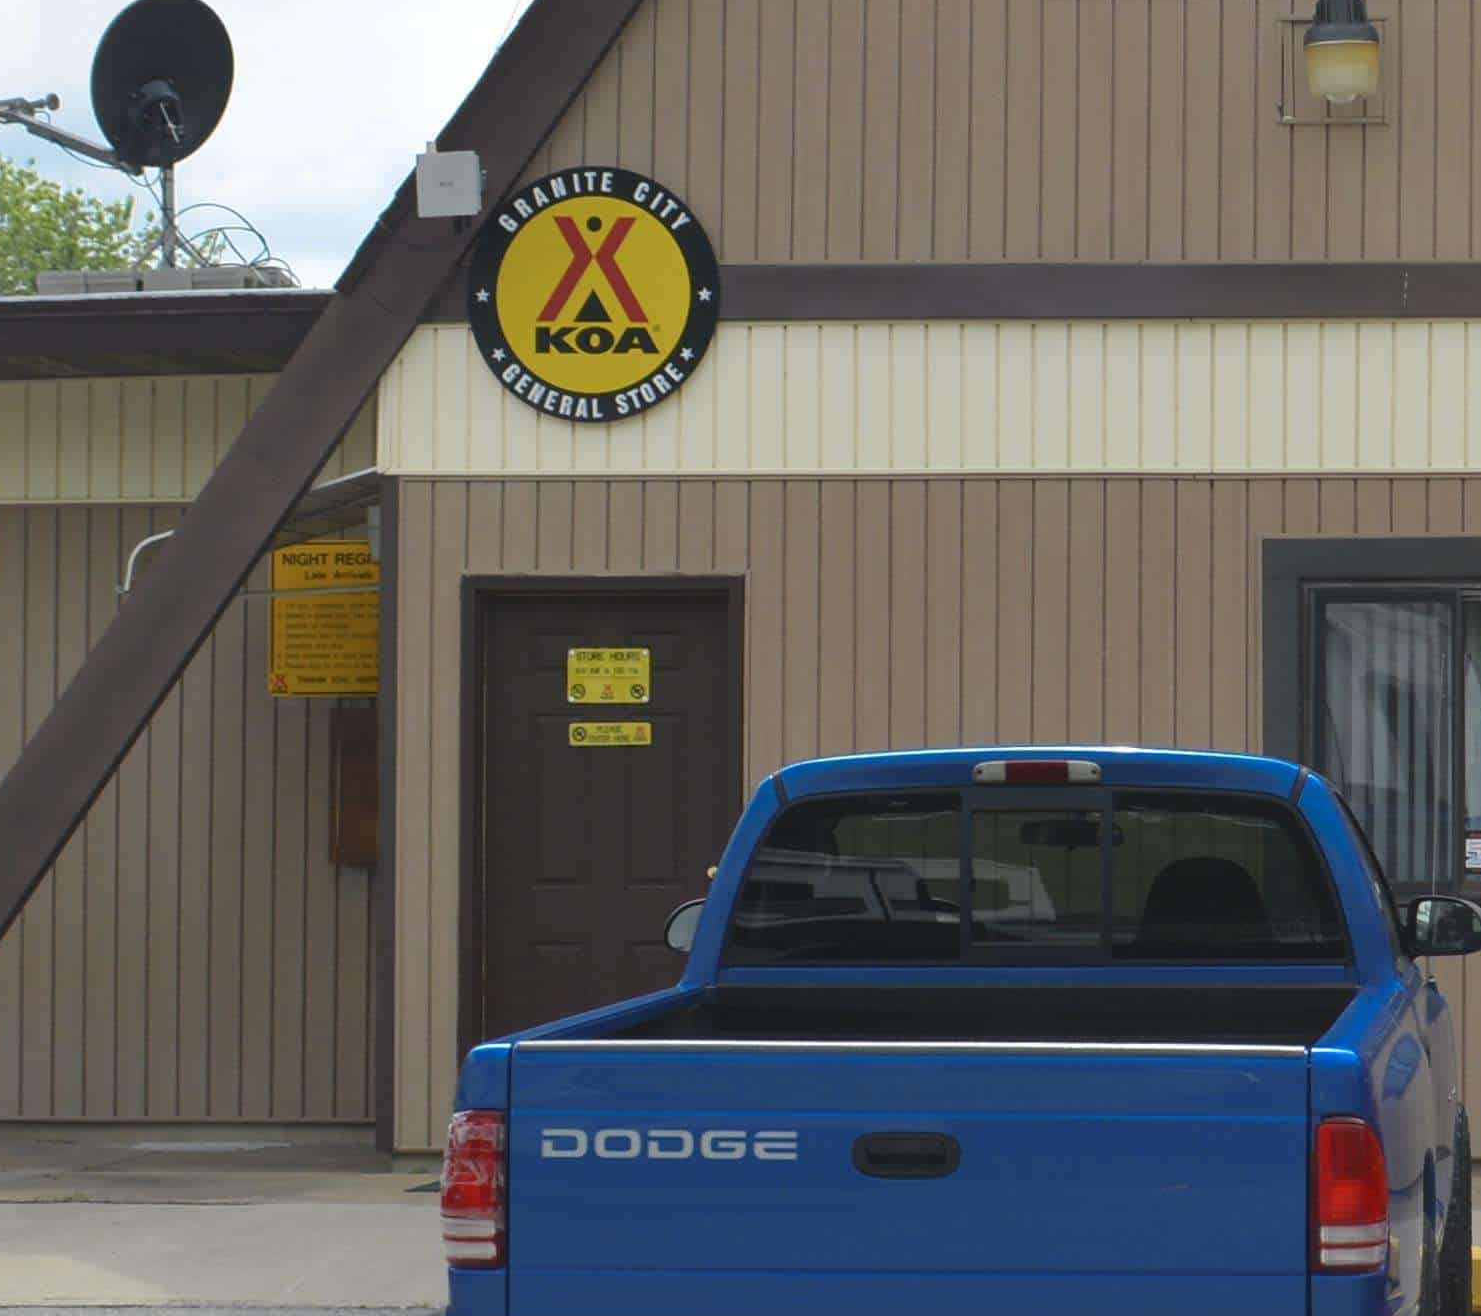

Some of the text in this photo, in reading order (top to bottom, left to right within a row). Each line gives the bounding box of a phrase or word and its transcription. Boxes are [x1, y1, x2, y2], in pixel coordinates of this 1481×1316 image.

[498, 171, 691, 234] GRANITE CITY
[535, 326, 660, 354] KOA
[502, 362, 684, 419] GENERAL STORE
[281, 552, 328, 565] NIGHT
[576, 651, 603, 661] STORE
[541, 1128, 798, 1160] DODGE
